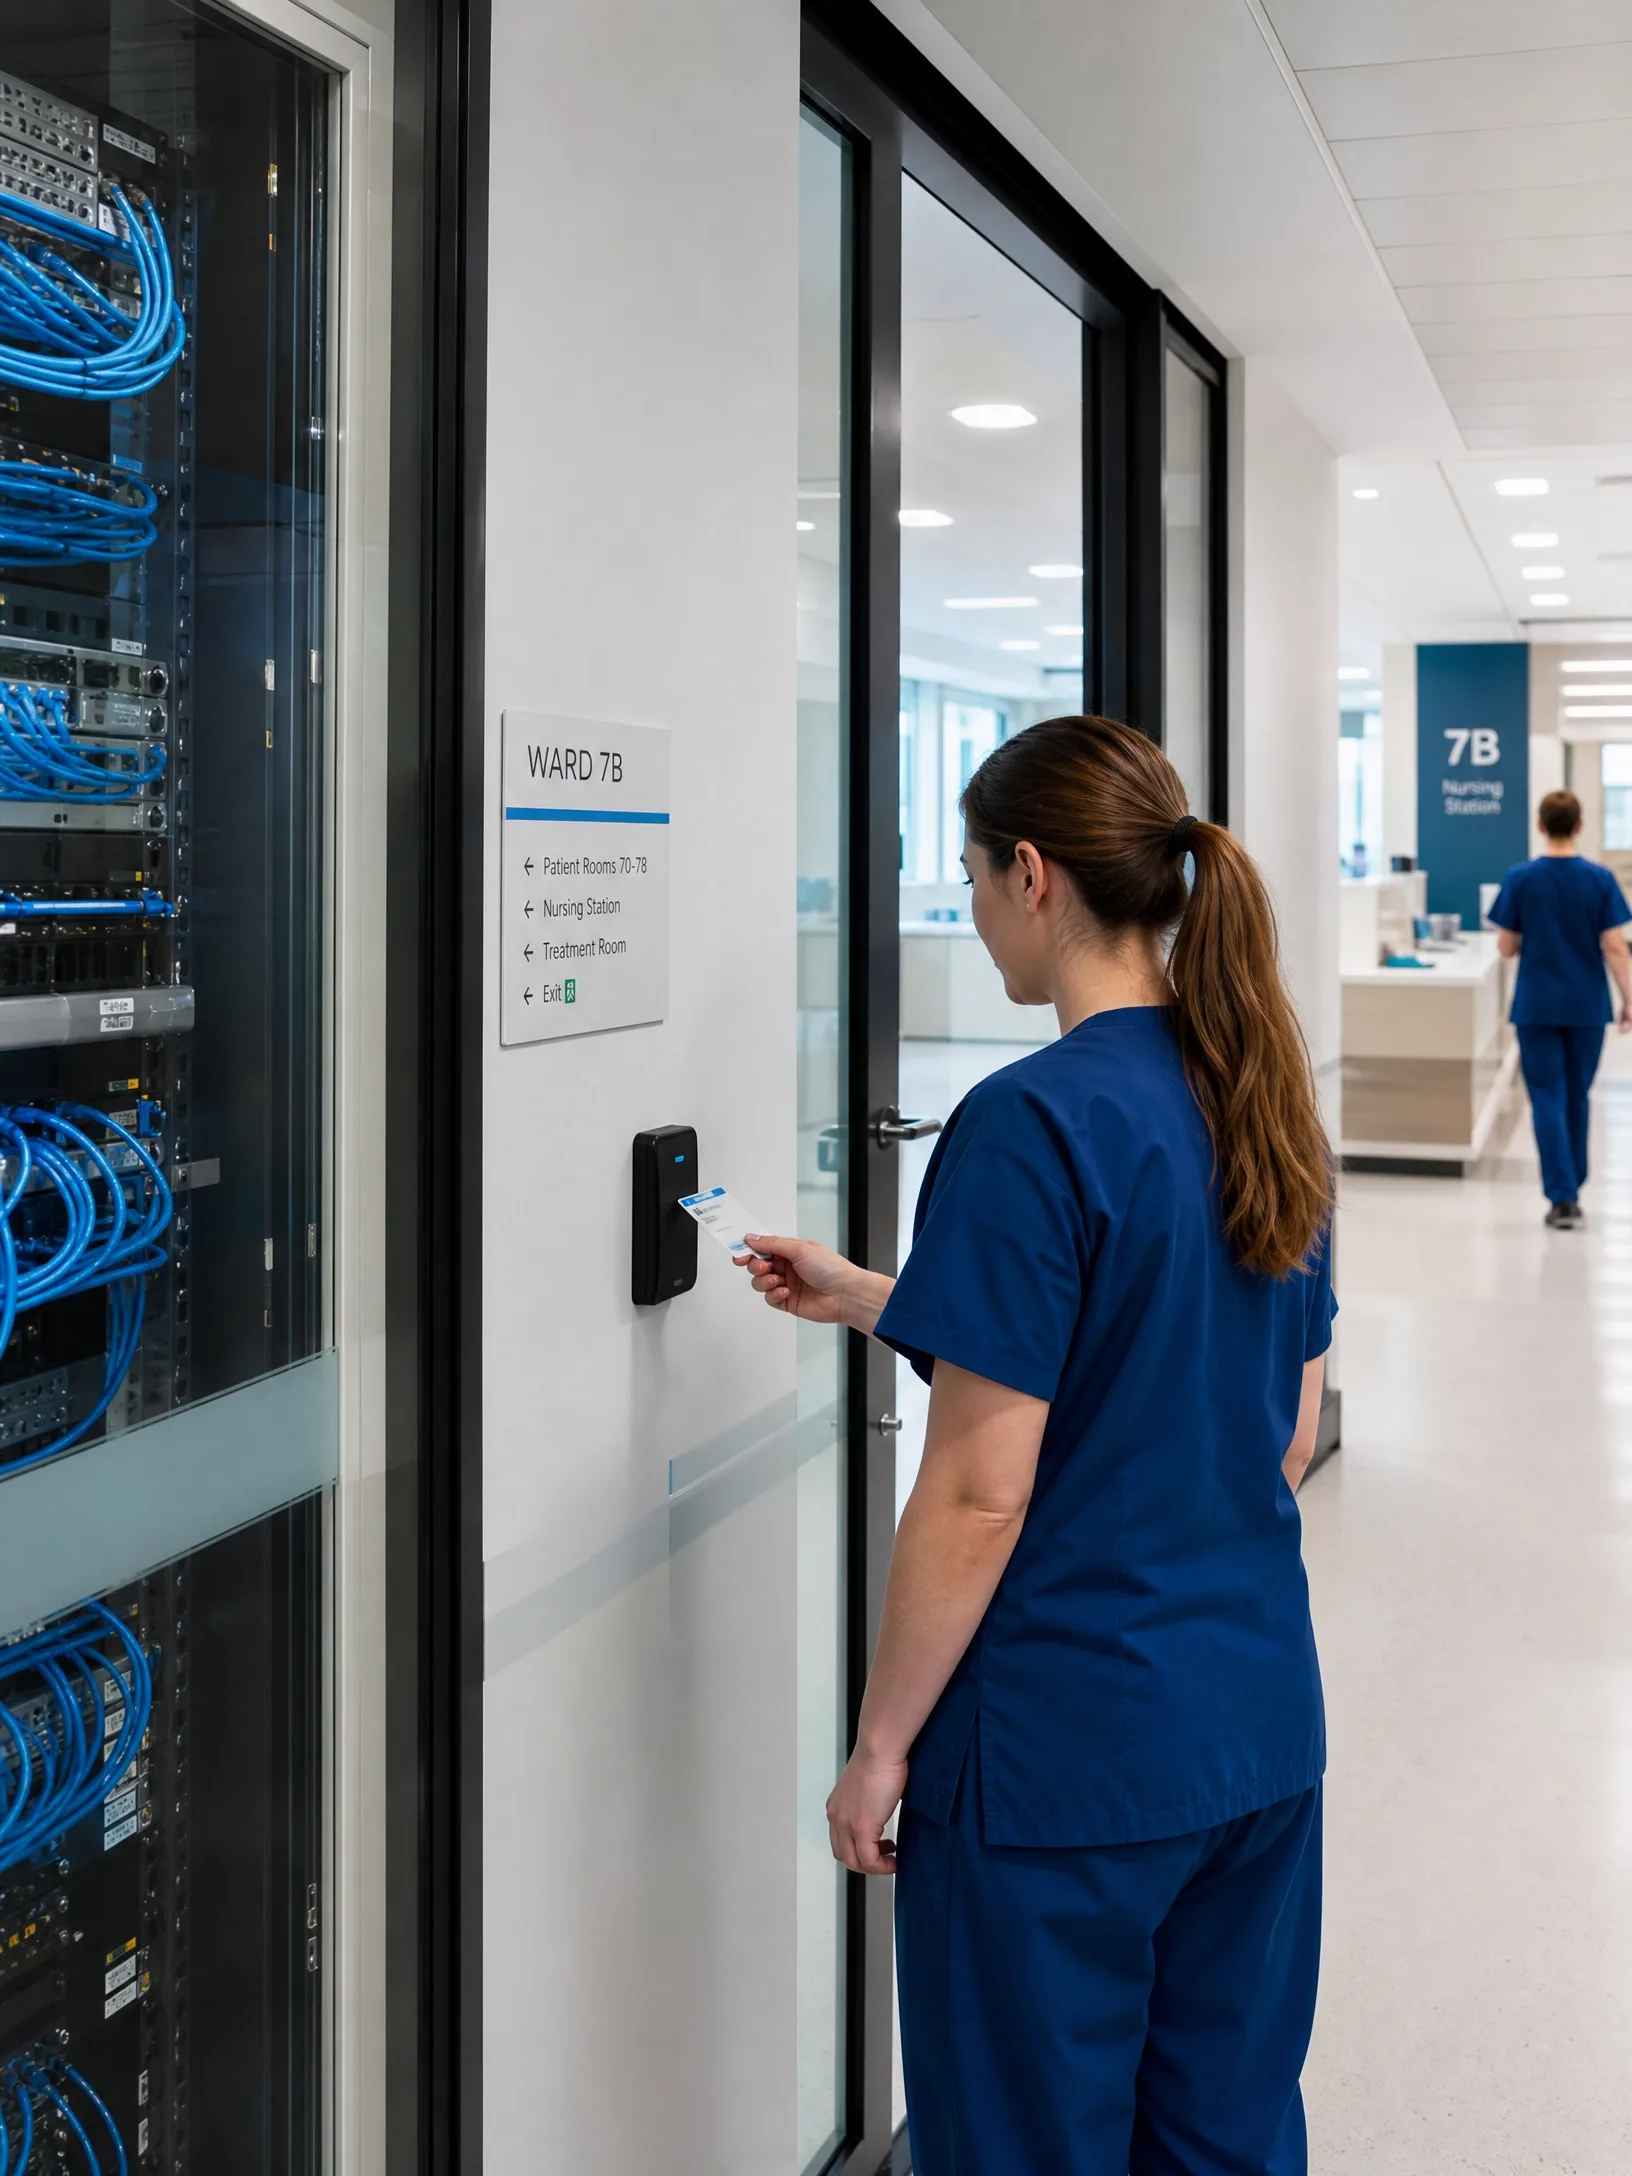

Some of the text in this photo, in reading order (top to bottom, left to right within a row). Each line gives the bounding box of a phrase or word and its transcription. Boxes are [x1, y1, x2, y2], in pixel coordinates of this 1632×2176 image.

[1443, 728, 1501, 766] 7B
[528, 745, 623, 783] WARD 7B
[1442, 779, 1504, 799] Nursing
[1444, 798, 1502, 815] Station
[543, 857, 648, 875] Patient Rooms 70-78
[543, 898, 620, 920] Nursing Station
[543, 939, 627, 961] Treatment Room
[543, 984, 562, 1004] Exit
